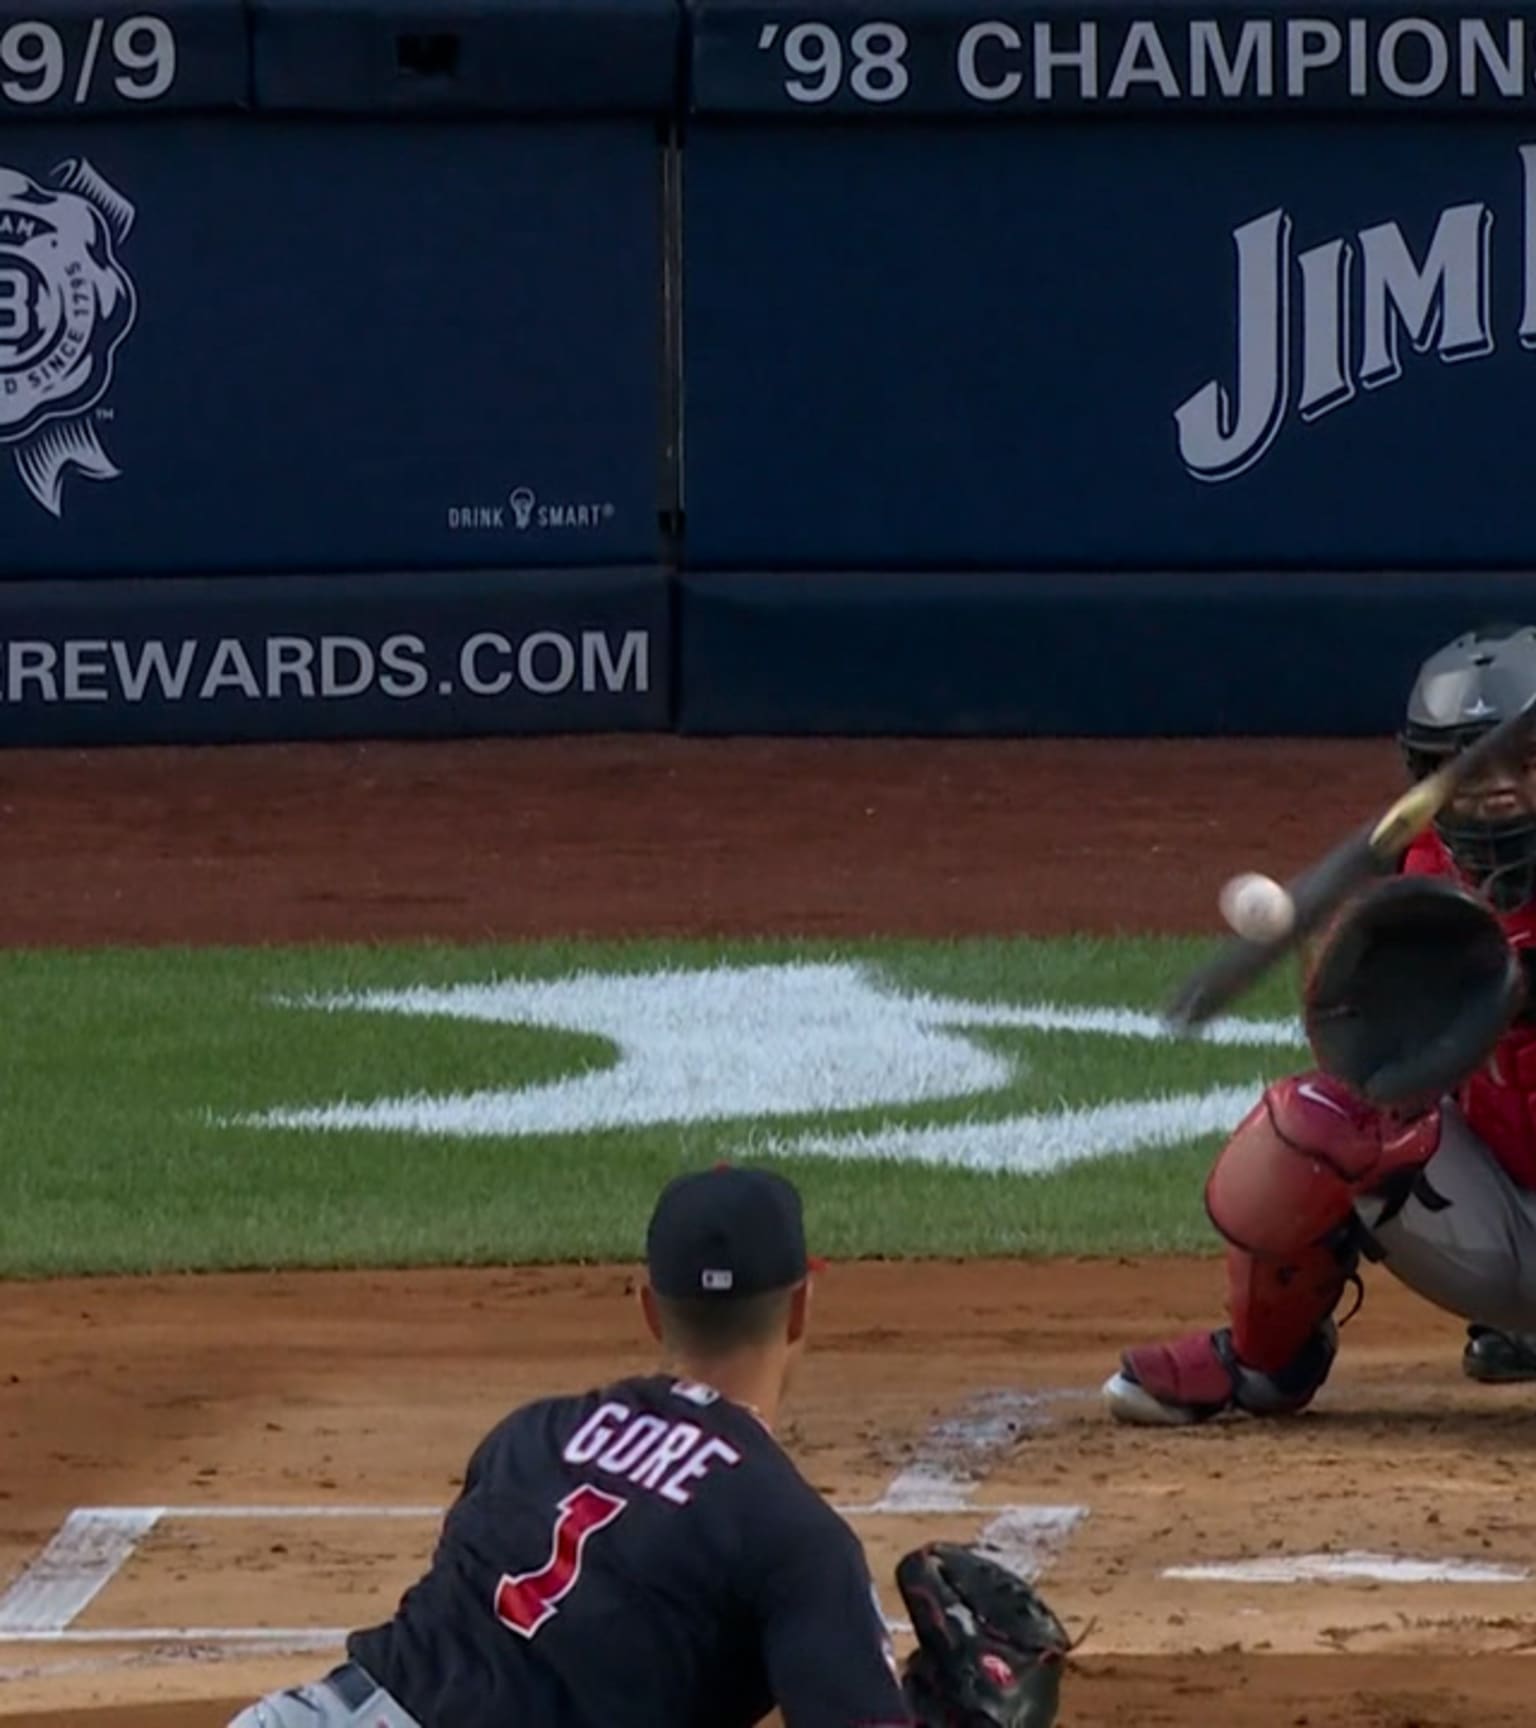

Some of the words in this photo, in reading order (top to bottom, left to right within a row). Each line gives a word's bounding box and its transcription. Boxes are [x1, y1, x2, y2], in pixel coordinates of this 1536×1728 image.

[0, 17, 175, 102] 9/9
[758, 22, 909, 101] '98
[28, 329, 85, 388] SINCE
[65, 261, 90, 318] 1795
[1174, 203, 1494, 482] JIM
[448, 507, 504, 529] DRINK
[0, 630, 649, 701] REWARDS.COM
[564, 1402, 740, 1504] GORE
[495, 1484, 628, 1638] 1
